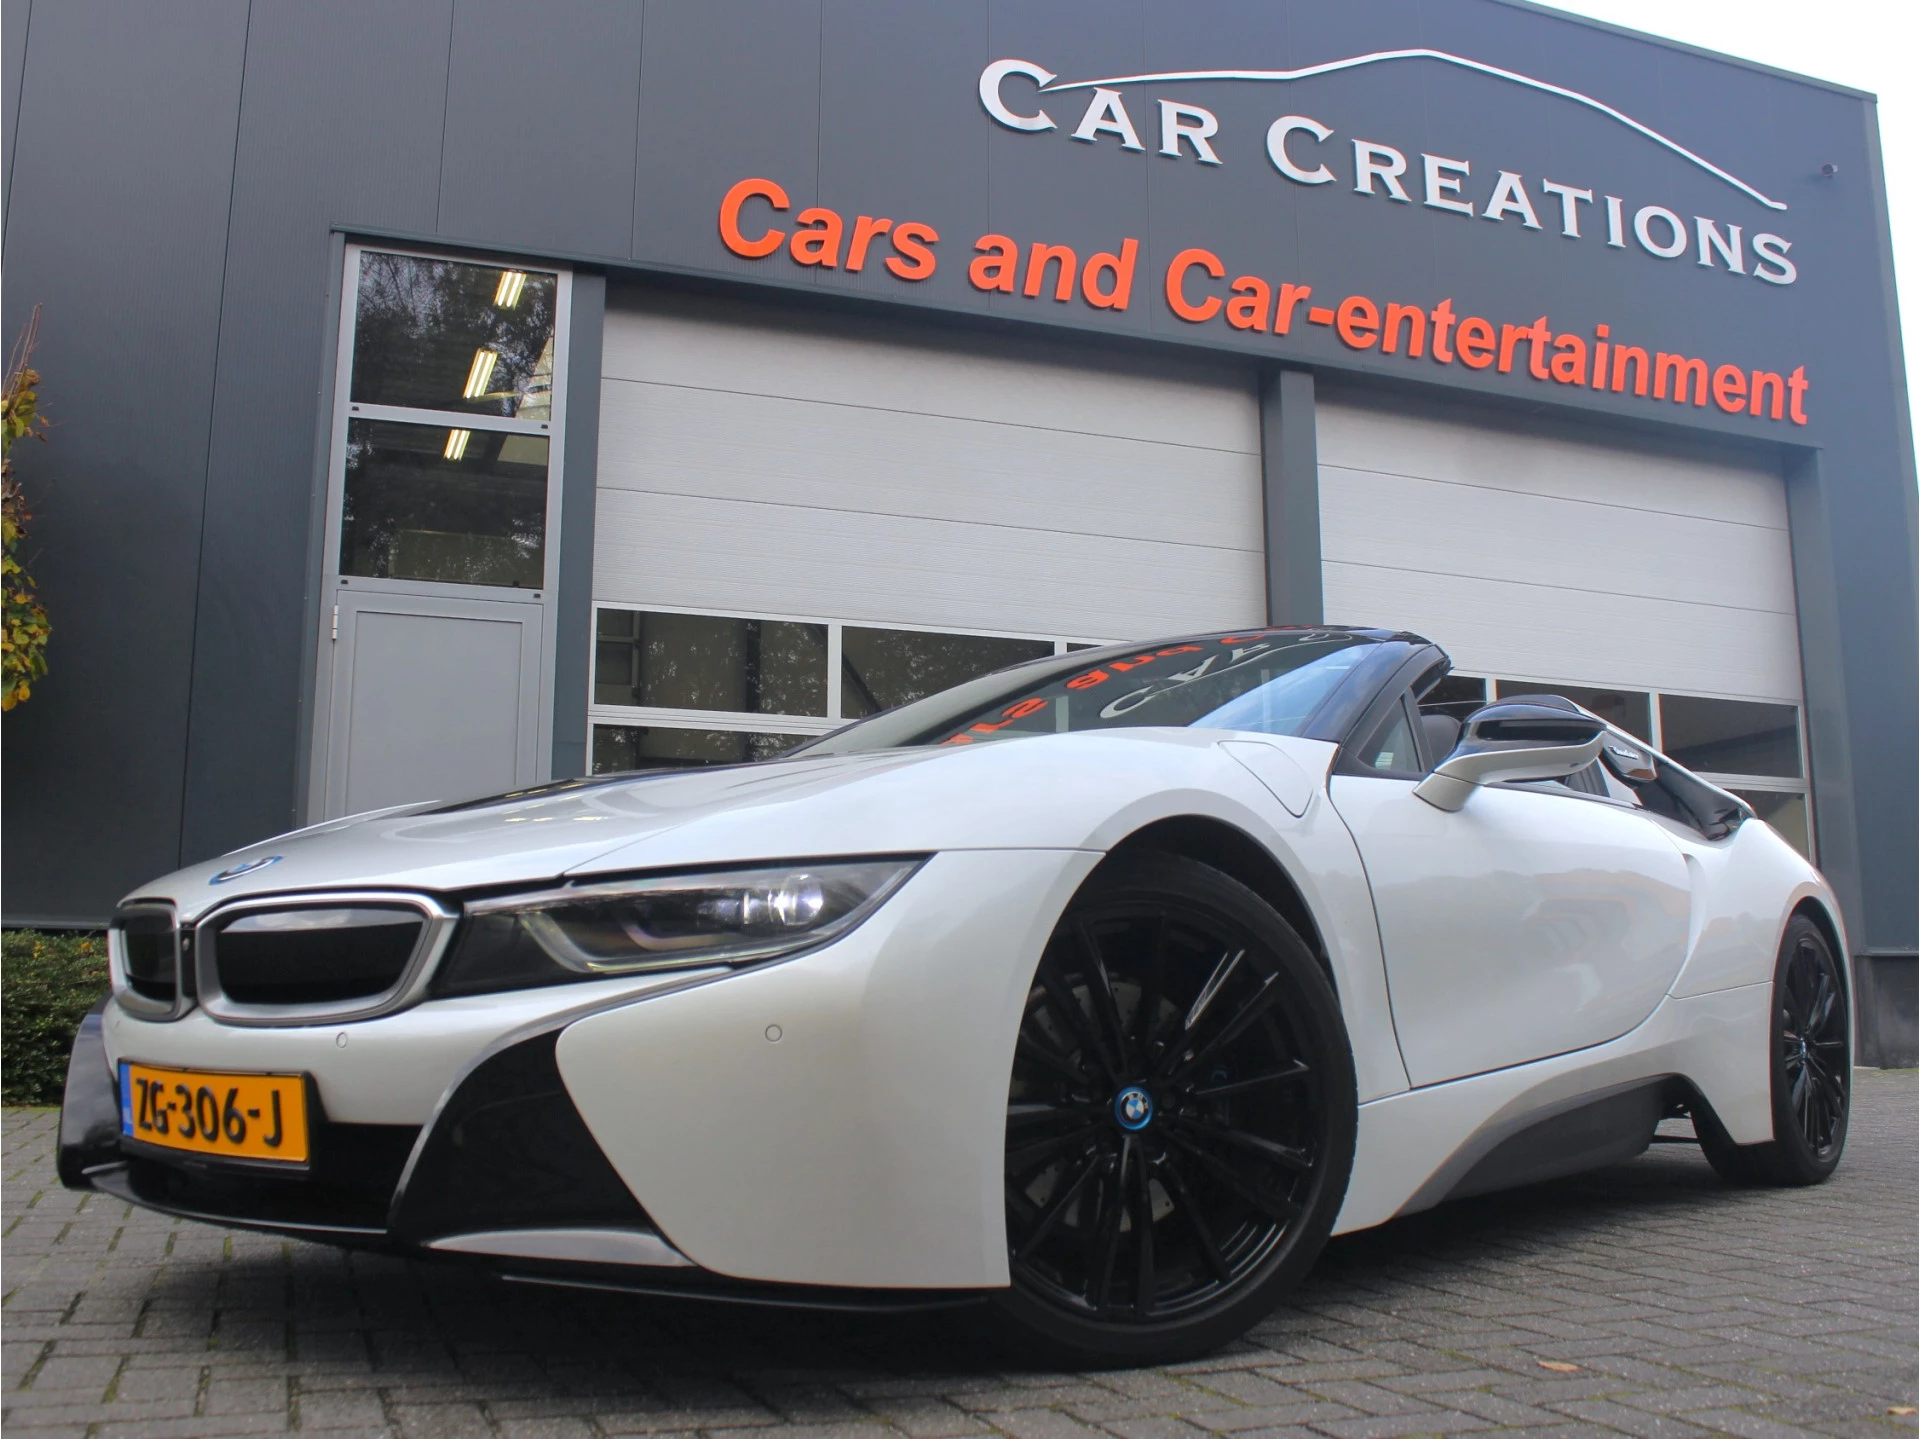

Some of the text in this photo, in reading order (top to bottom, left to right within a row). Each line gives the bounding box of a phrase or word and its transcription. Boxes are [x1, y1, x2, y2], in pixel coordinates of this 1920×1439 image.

[980, 58, 1798, 286] CAR CREATIONS
[719, 178, 1809, 425] Cars and Car-entertainment
[136, 1078, 284, 1147] ZG-306-J
